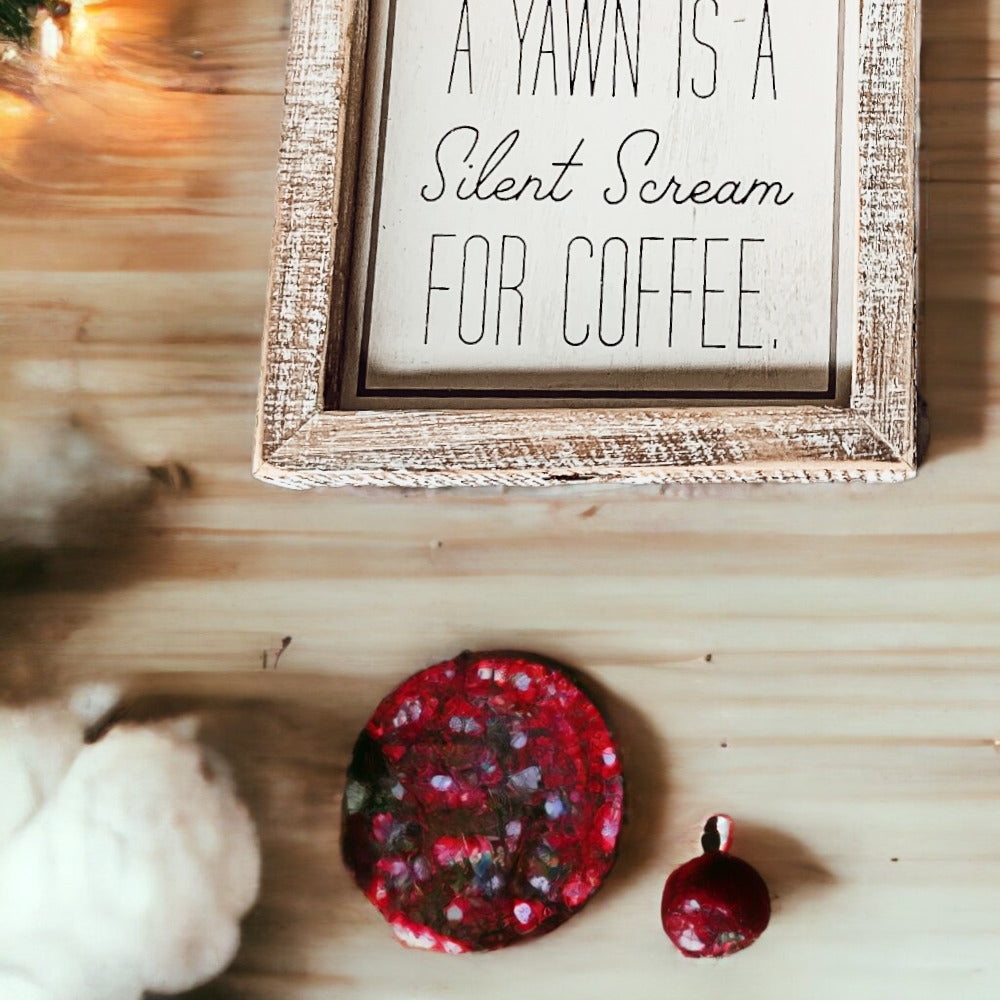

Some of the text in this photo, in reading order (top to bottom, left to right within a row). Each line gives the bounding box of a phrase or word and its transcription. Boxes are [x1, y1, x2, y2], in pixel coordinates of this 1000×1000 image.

[420, 125, 795, 206] Silent Scream
[423, 233, 779, 350] FOR COFFEE.
